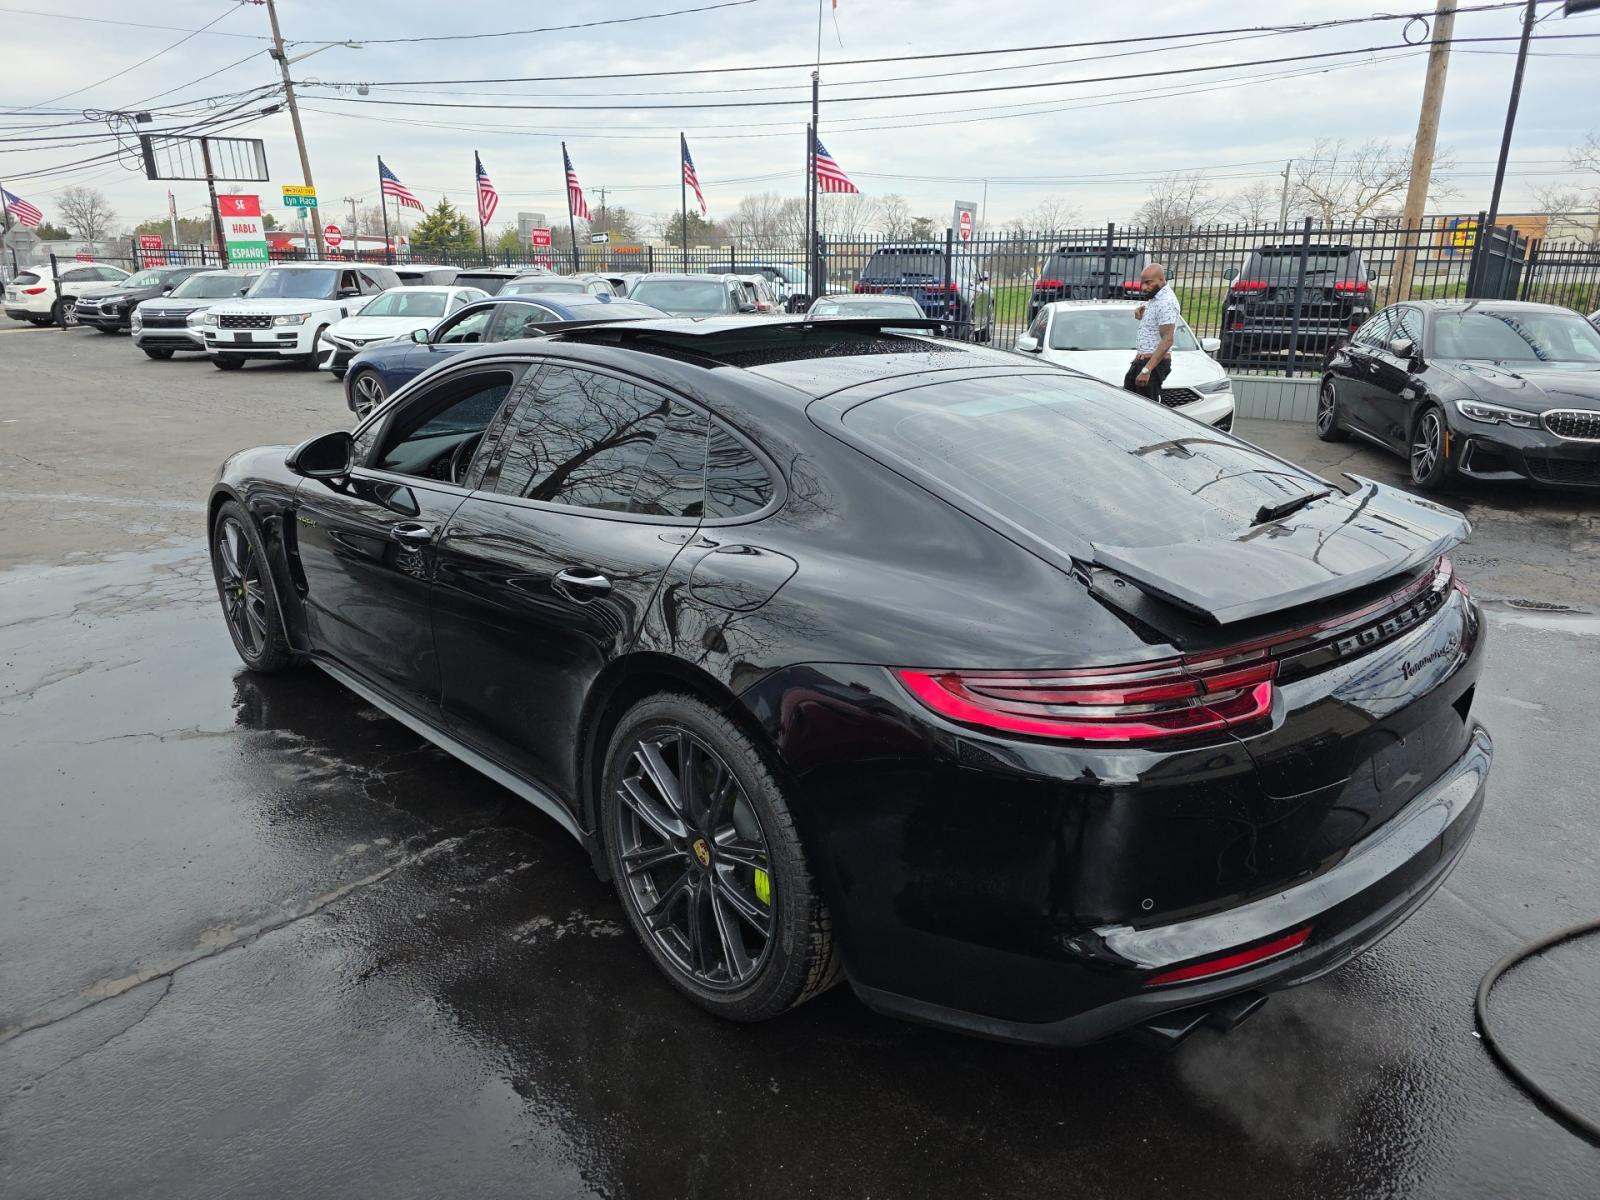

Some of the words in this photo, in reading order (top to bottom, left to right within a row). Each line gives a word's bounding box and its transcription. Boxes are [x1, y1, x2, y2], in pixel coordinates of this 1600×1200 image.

[235, 199, 246, 210] SE
[300, 197, 316, 206] Place
[232, 223, 257, 234] HABLA
[232, 246, 265, 259] ESPAÑOL
